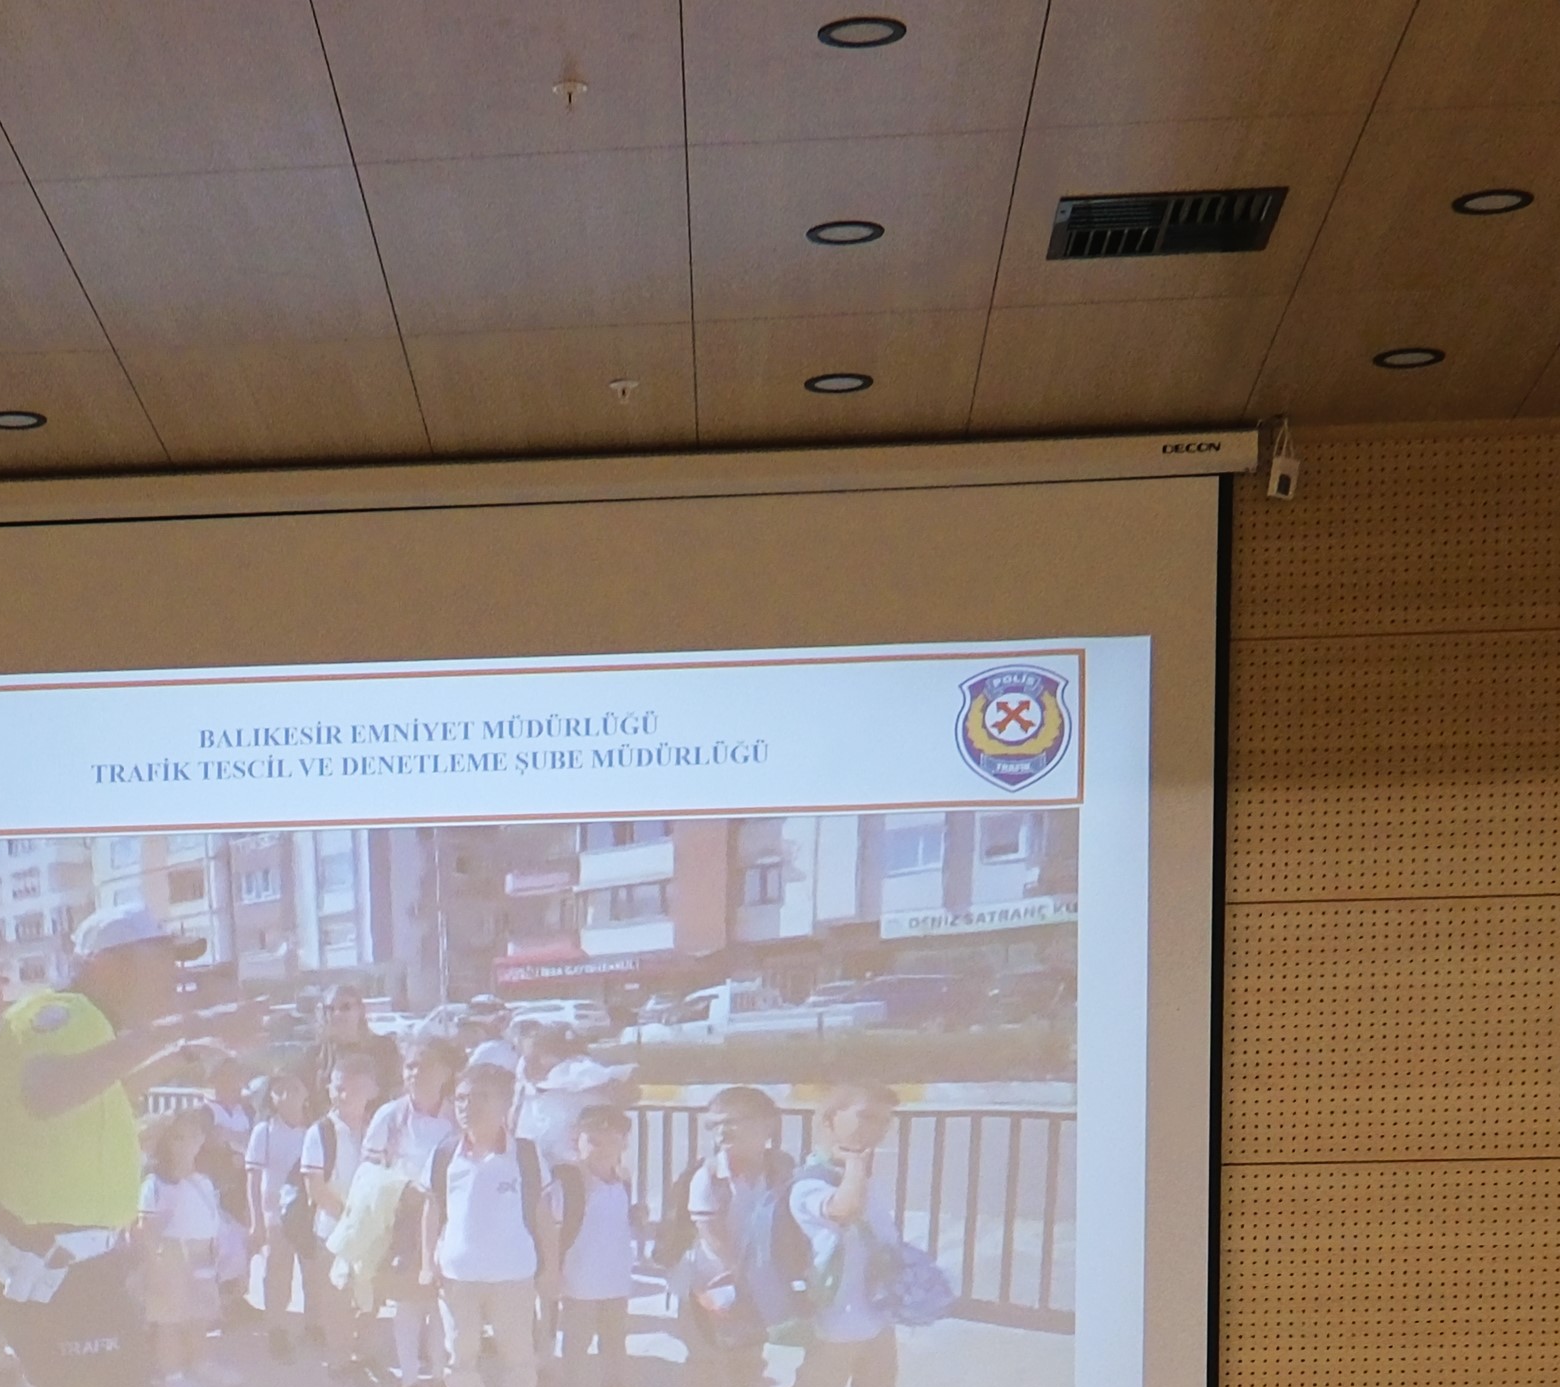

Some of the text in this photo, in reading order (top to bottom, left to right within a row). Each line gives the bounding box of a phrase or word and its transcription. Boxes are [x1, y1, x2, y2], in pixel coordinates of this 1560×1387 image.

[1162, 442, 1221, 454] DECON
[199, 710, 659, 749] BALIKESİR EMNİYET MÜDÜRLÜĞÜ
[91, 739, 770, 784] TRAFİK TESCİL VE DENETLEME ŞUBE MÜDÜRLÜĞÜ
